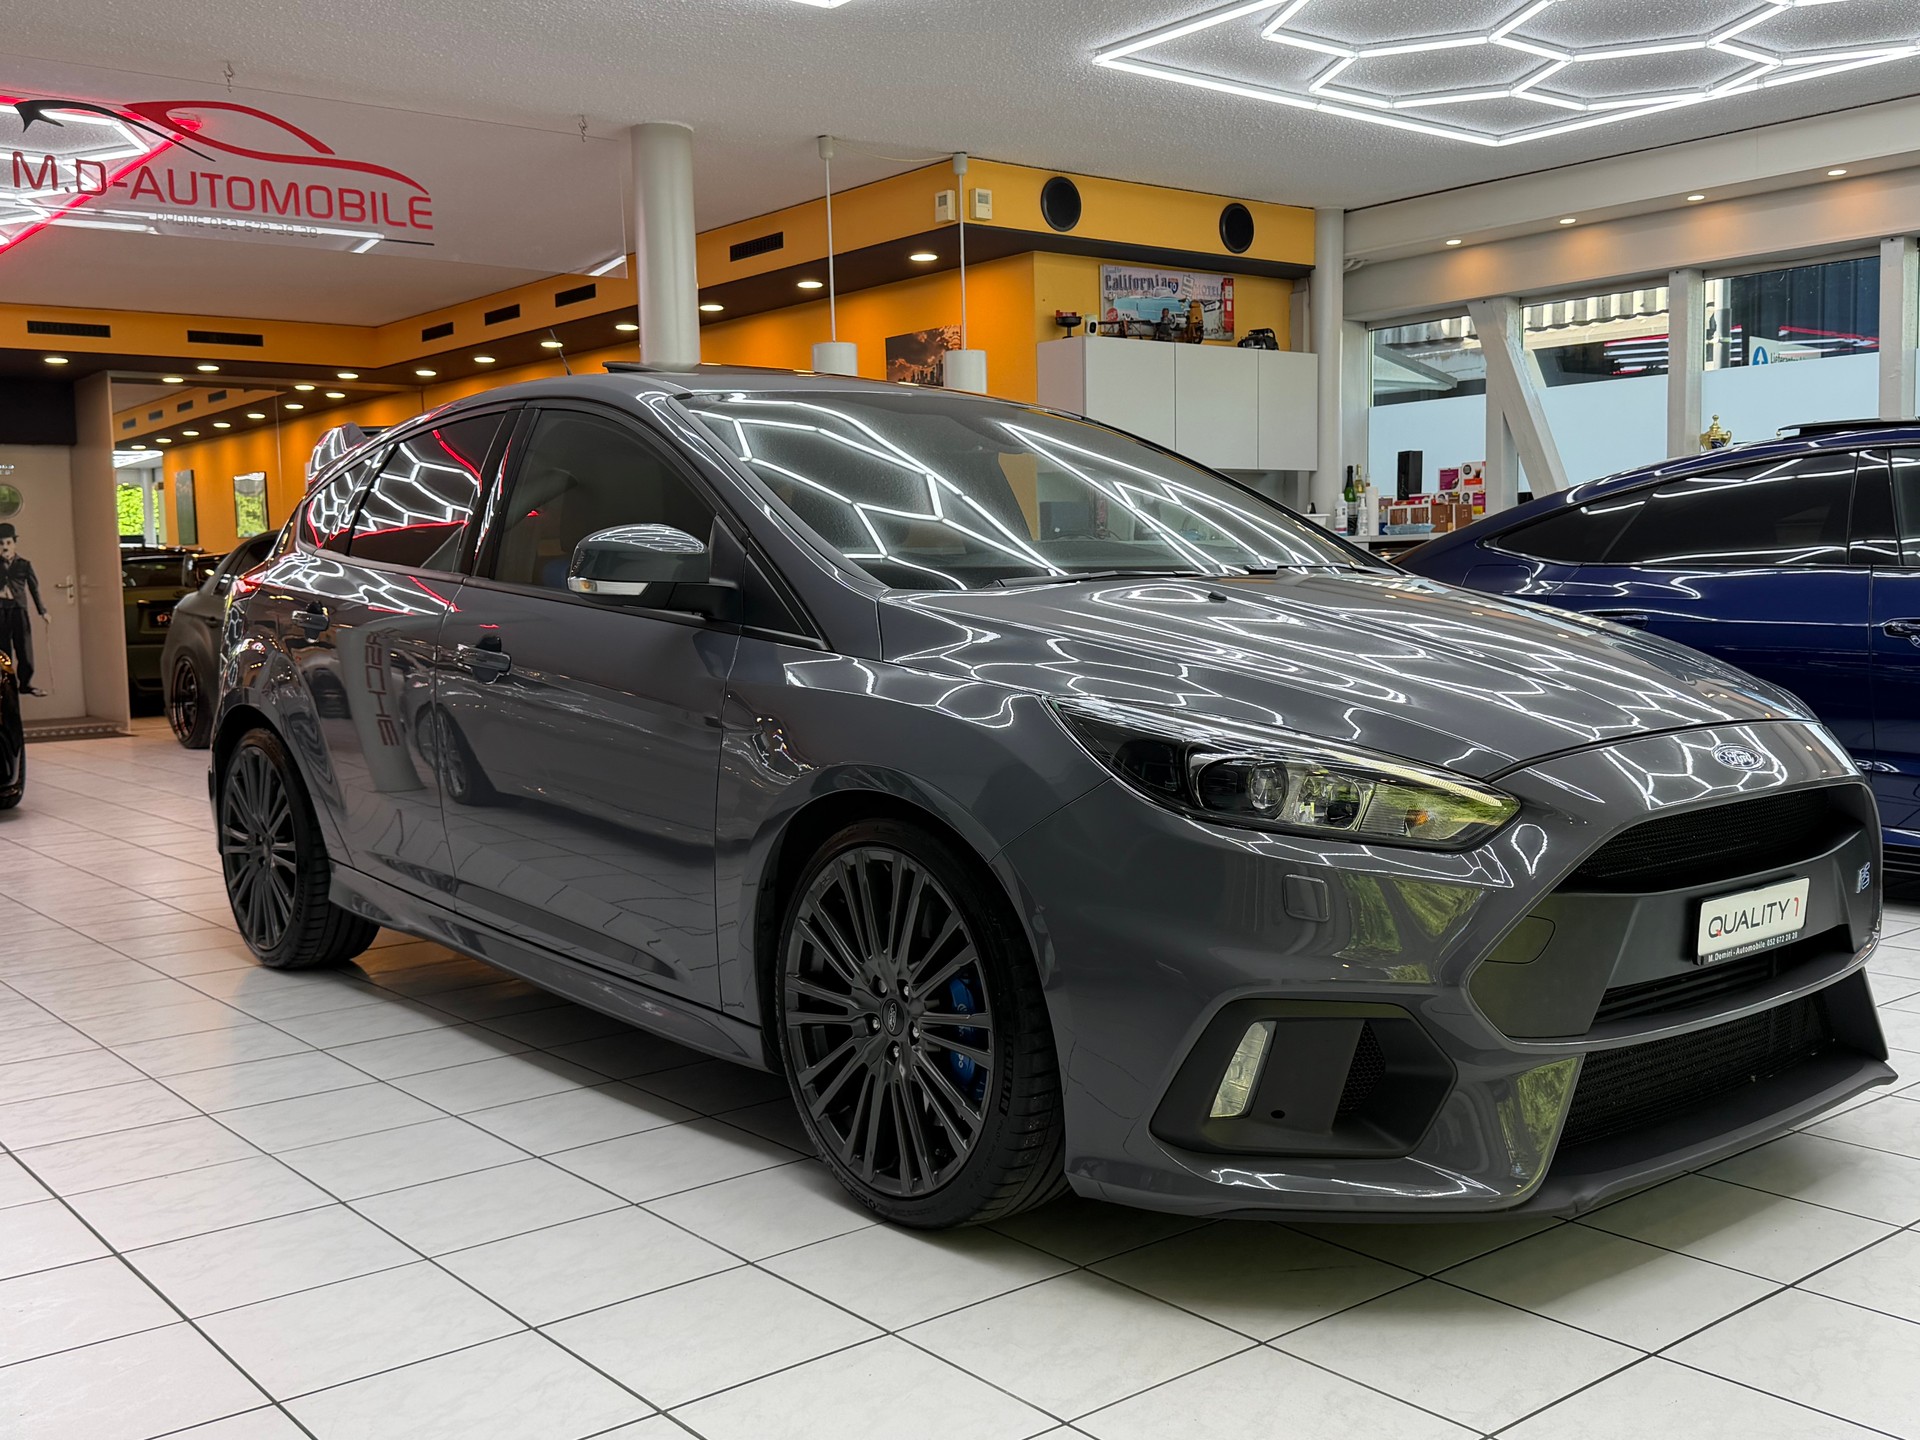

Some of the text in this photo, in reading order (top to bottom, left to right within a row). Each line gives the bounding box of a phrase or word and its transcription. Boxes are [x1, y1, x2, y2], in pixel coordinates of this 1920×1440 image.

[157, 212, 205, 228] PHONE
[1105, 274, 1167, 291] California
[1708, 897, 1799, 938] QUALITY 1
[1767, 937, 1775, 947] 052
[1776, 935, 1785, 944] 672
[999, 1027, 1014, 1117] ICHELIN
